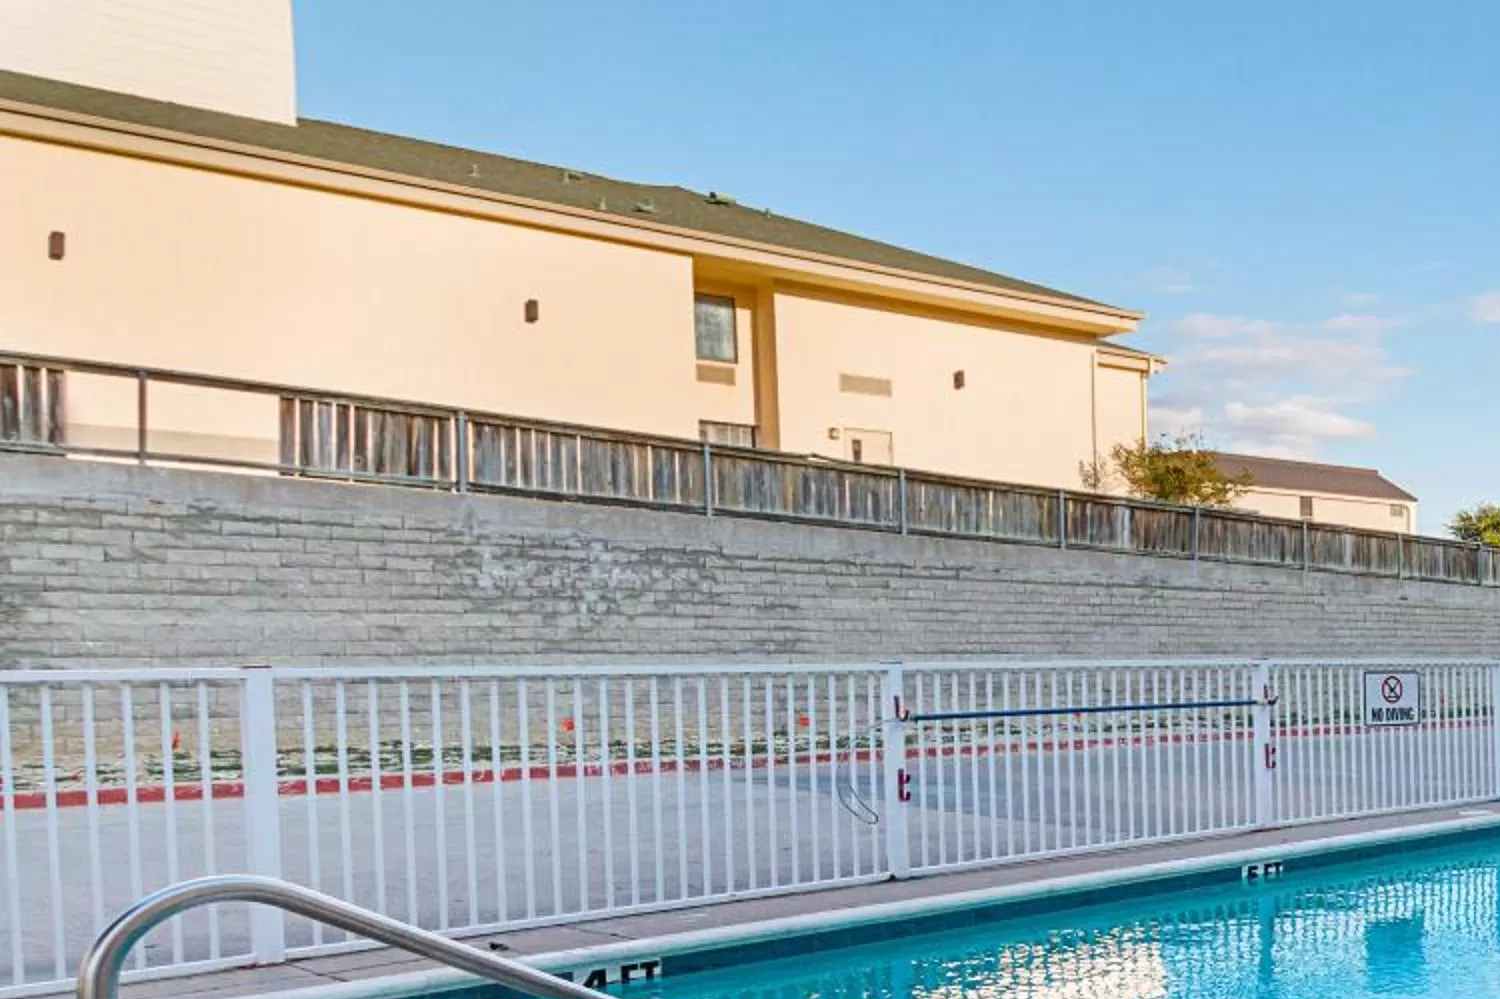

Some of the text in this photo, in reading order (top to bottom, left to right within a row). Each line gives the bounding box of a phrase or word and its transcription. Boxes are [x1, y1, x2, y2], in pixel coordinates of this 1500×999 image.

[1371, 707, 1415, 722] NO DIVING
[620, 960, 660, 985] FT
